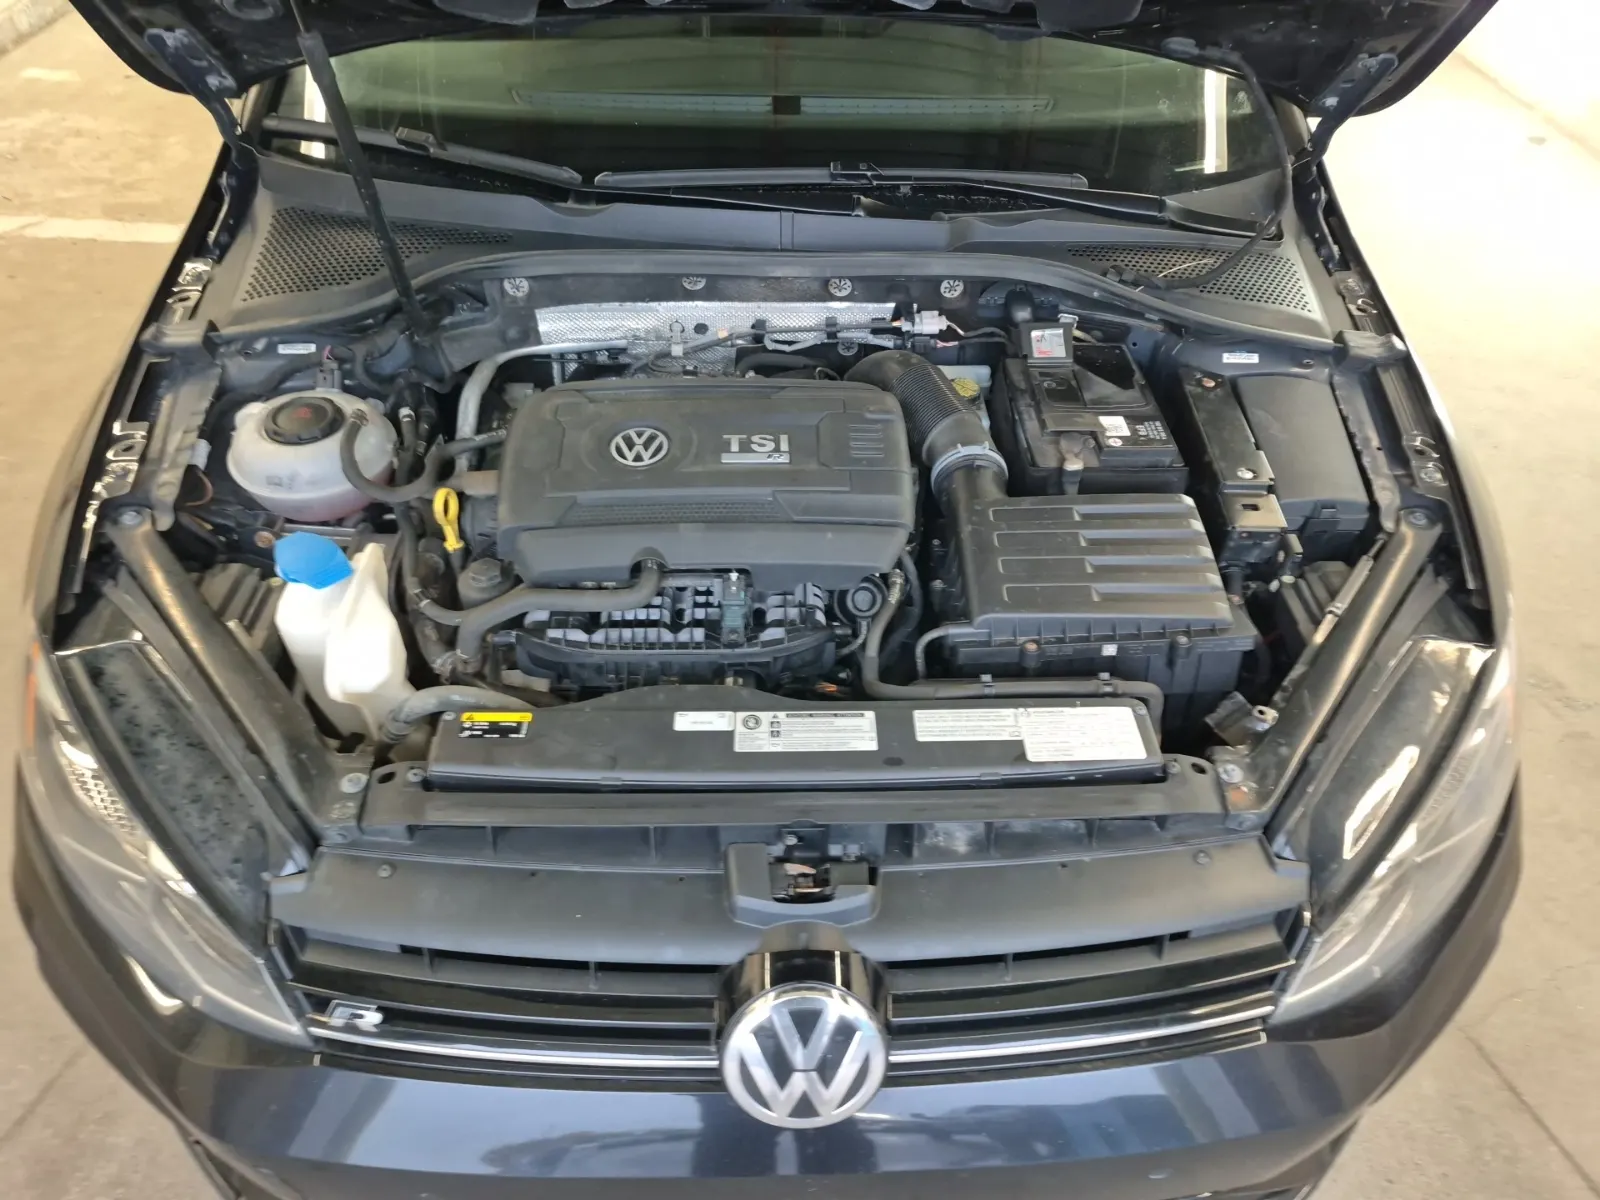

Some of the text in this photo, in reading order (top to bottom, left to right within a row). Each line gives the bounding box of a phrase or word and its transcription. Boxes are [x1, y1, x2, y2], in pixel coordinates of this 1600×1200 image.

[610, 427, 669, 466] VW
[722, 434, 790, 453] TSI
[327, 1004, 384, 1032] R
[723, 984, 887, 1129] VW
